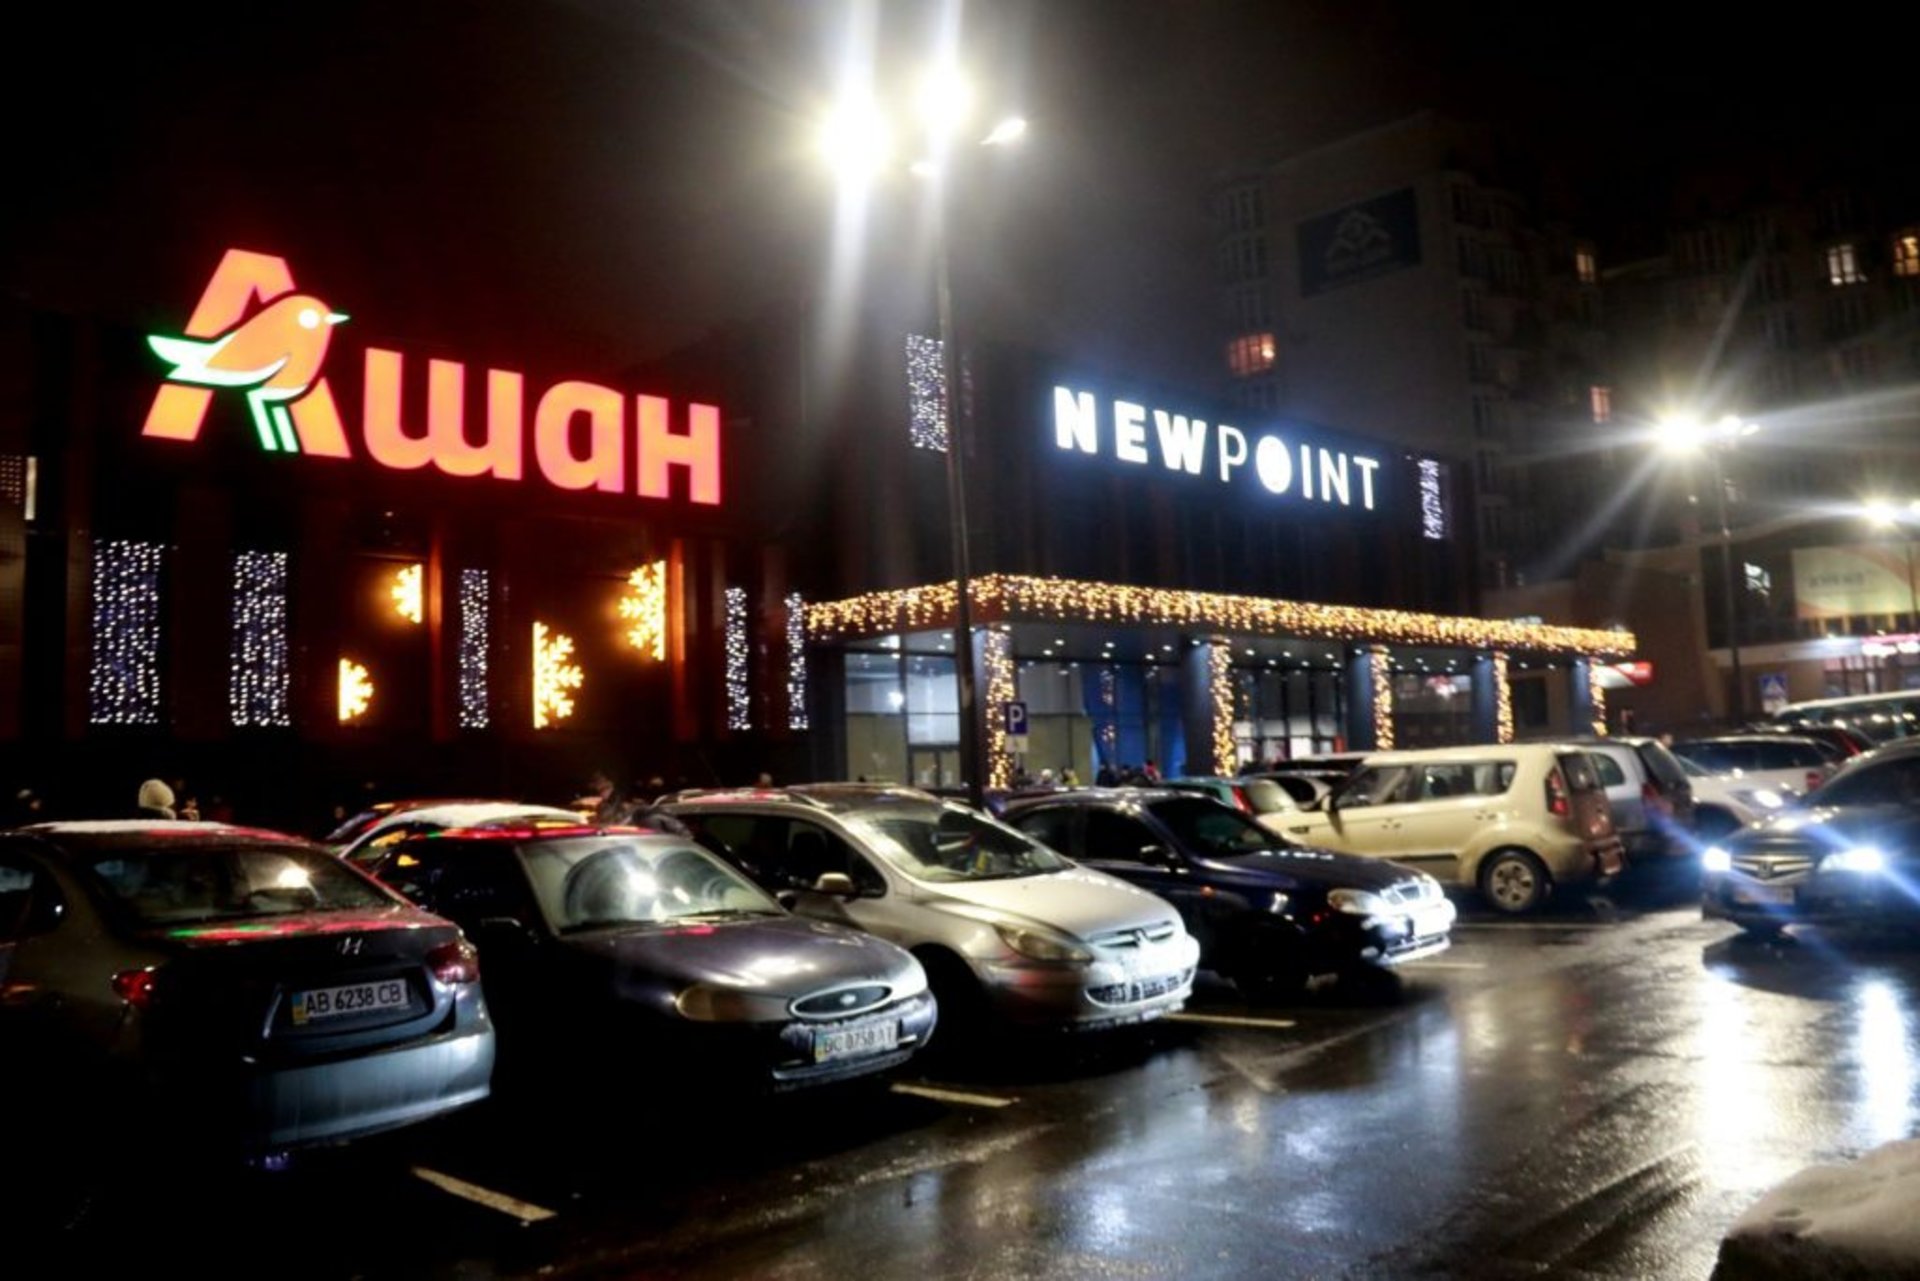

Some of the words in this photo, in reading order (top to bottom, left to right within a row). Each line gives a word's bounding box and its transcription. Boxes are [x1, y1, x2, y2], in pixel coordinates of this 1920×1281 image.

[141, 248, 721, 505] Ашан
[1009, 705, 1024, 732] P
[305, 991, 330, 1014] AB
[335, 986, 375, 1010] 6238
[377, 982, 402, 1004] CB
